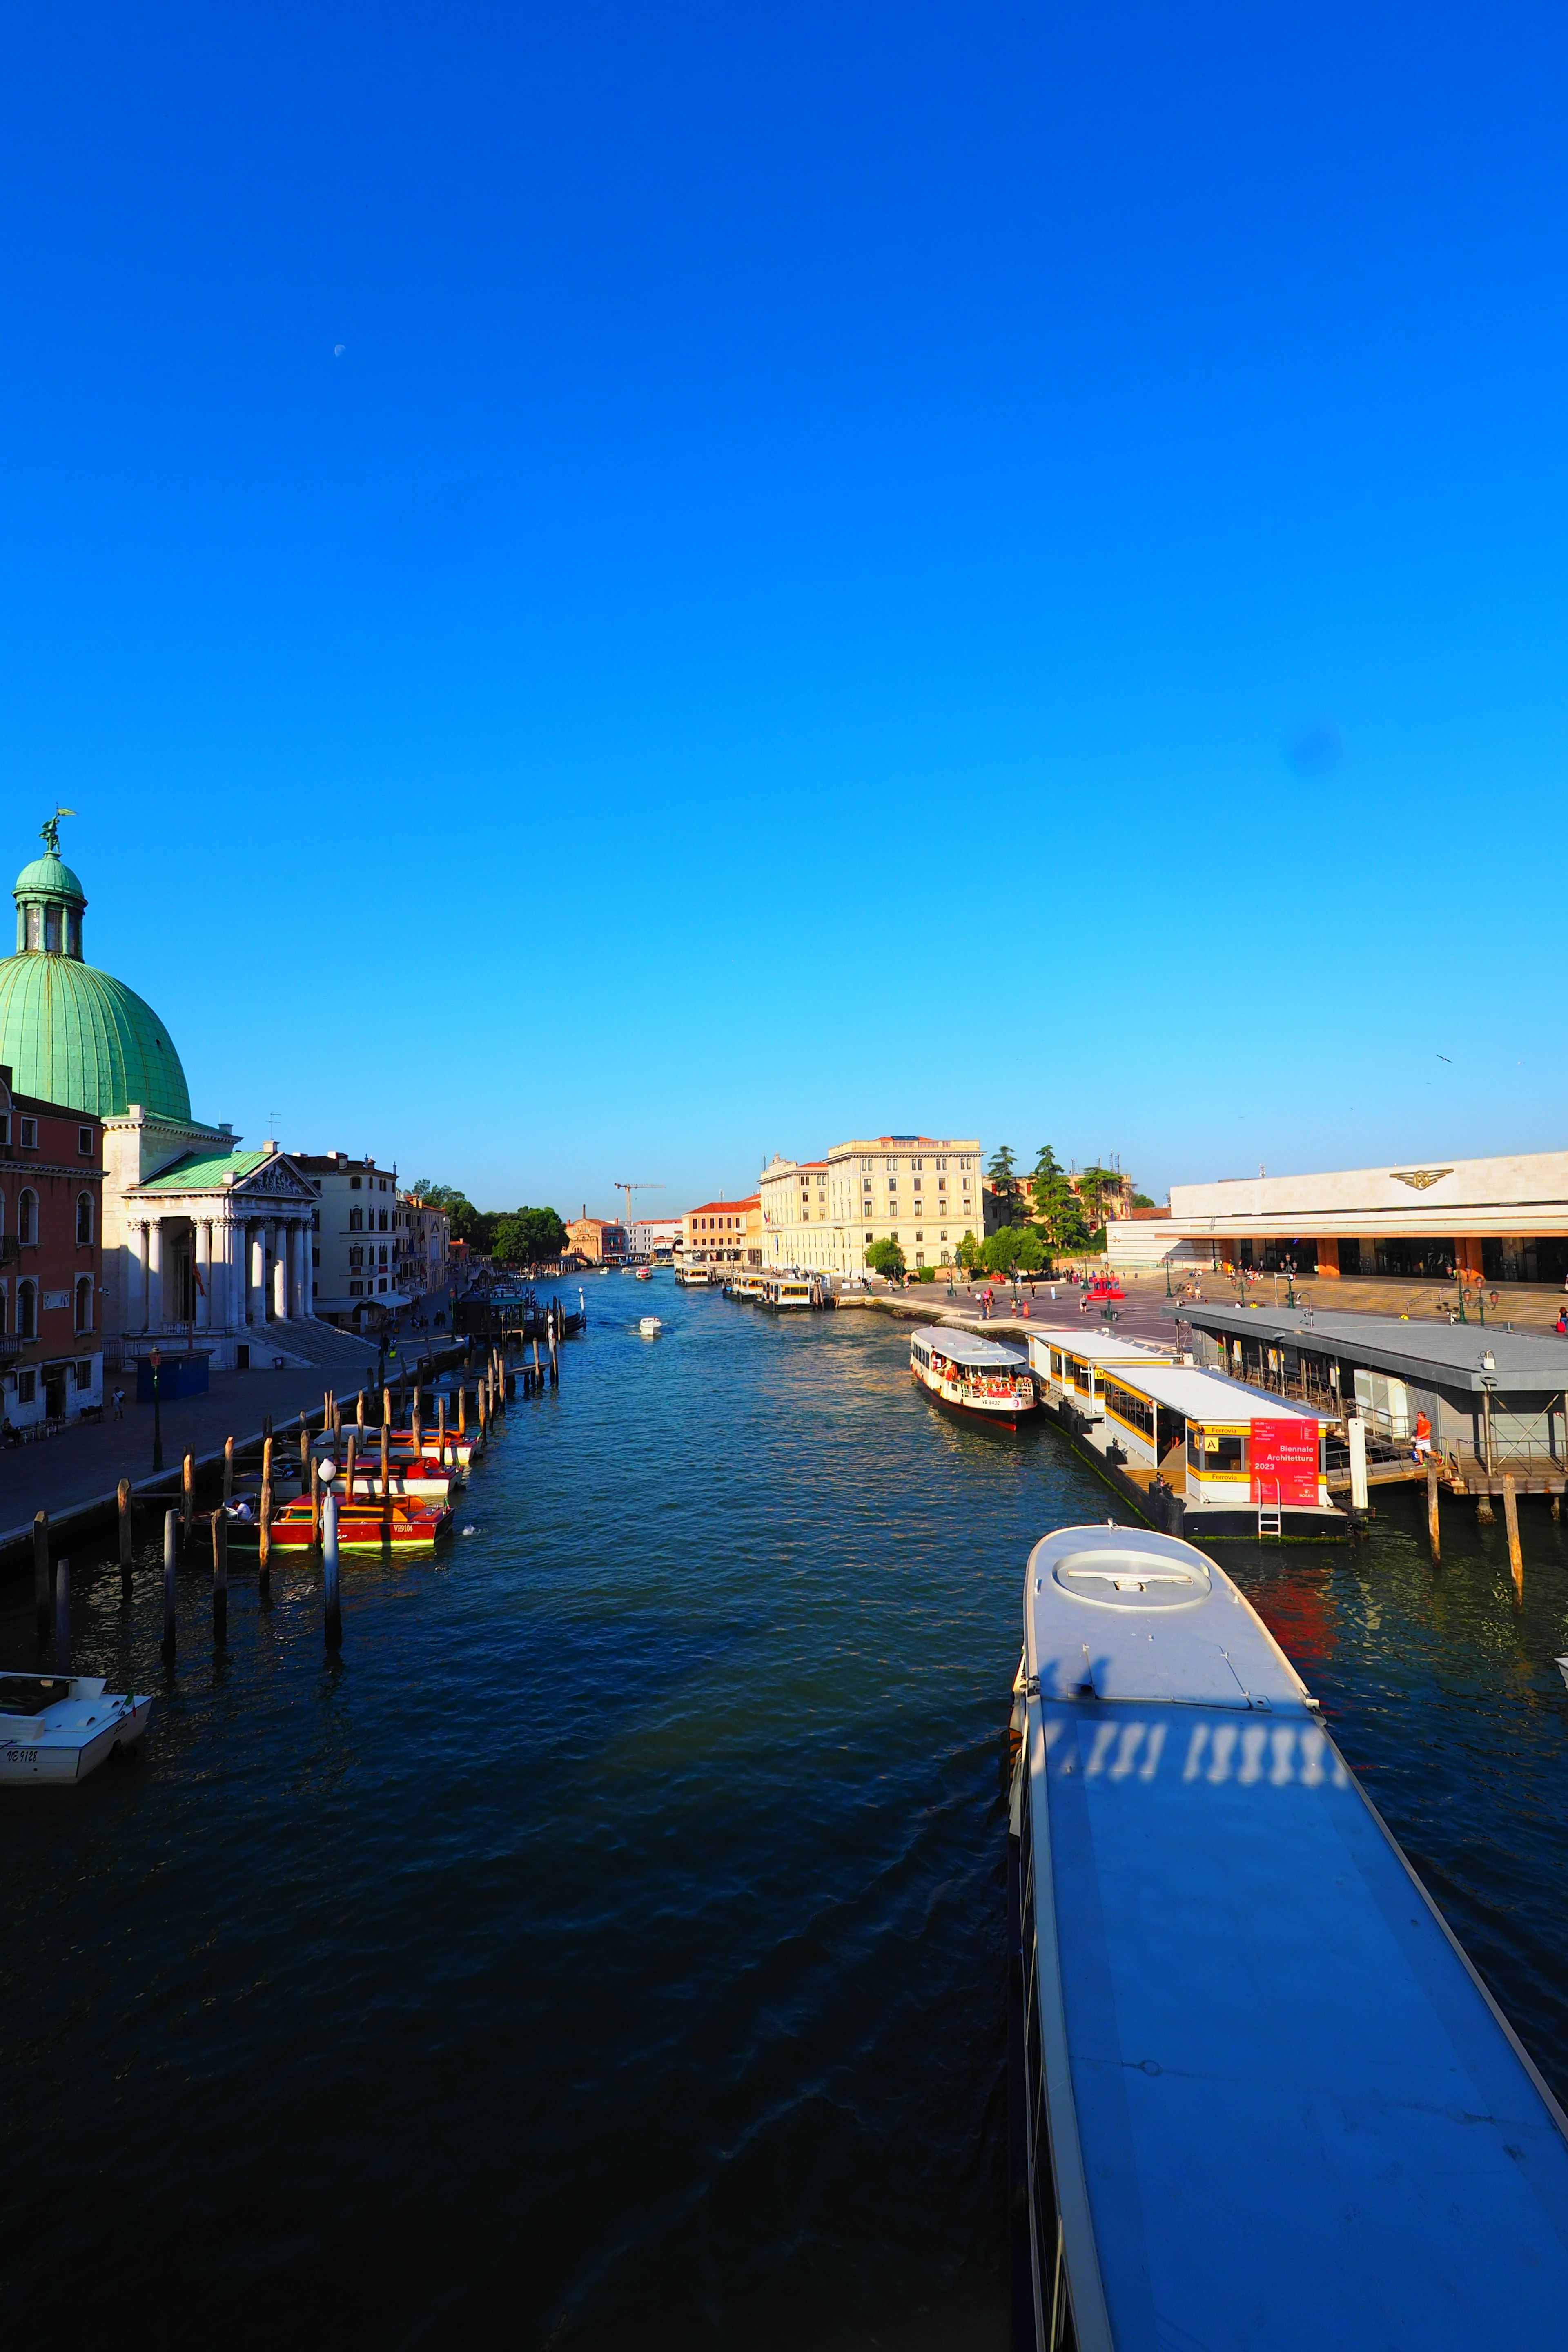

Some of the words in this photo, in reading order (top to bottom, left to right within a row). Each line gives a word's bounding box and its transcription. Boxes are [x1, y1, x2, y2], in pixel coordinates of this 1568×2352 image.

[1207, 1440, 1216, 1449] A
[7, 1750, 18, 1761] VE
[20, 1750, 38, 1762] 9128
